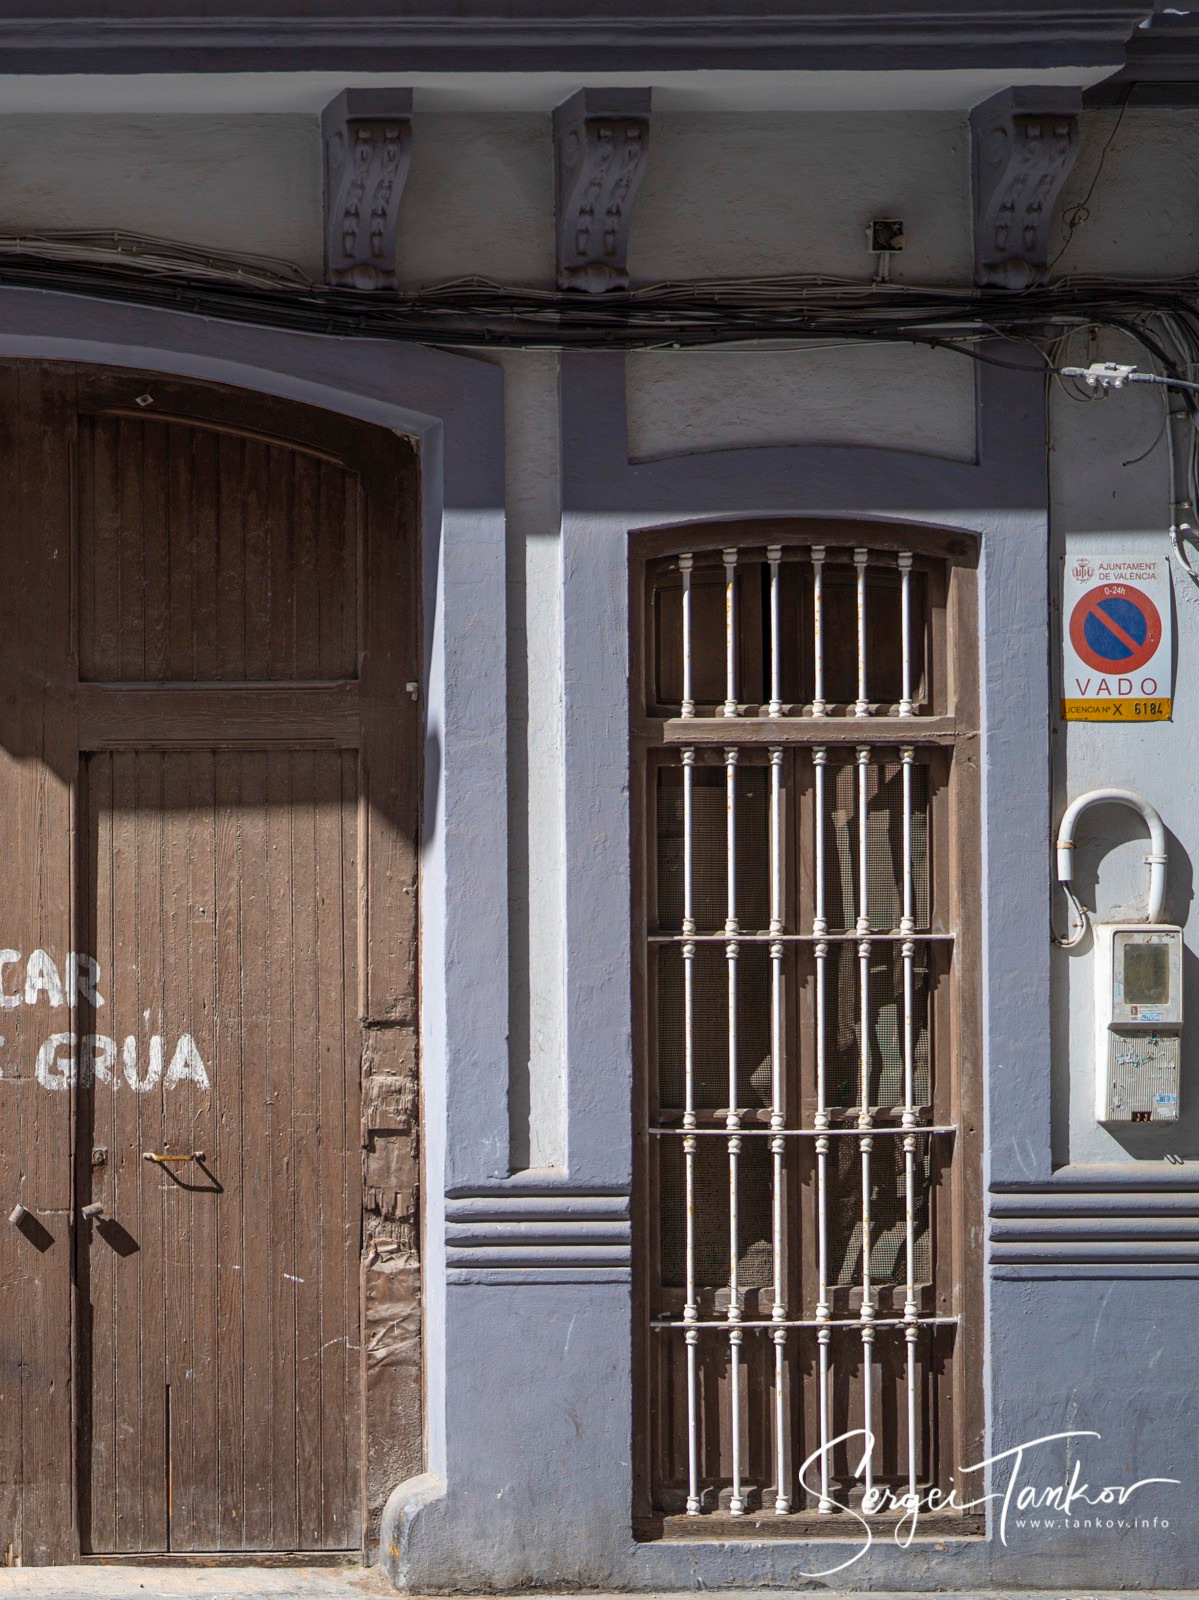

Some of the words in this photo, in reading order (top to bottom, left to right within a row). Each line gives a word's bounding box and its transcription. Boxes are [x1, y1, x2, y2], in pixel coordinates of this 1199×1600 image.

[1098, 562, 1157, 571] AJUNTAMENT
[1098, 572, 1111, 581] DE
[1104, 586, 1126, 595] 0-24h
[1075, 677, 1158, 696] VADO
[1064, 705, 1101, 714] LICENCIA
[1113, 703, 1123, 716] X
[1134, 702, 1163, 715] 6184
[36, 1031, 212, 1093] GRUA
